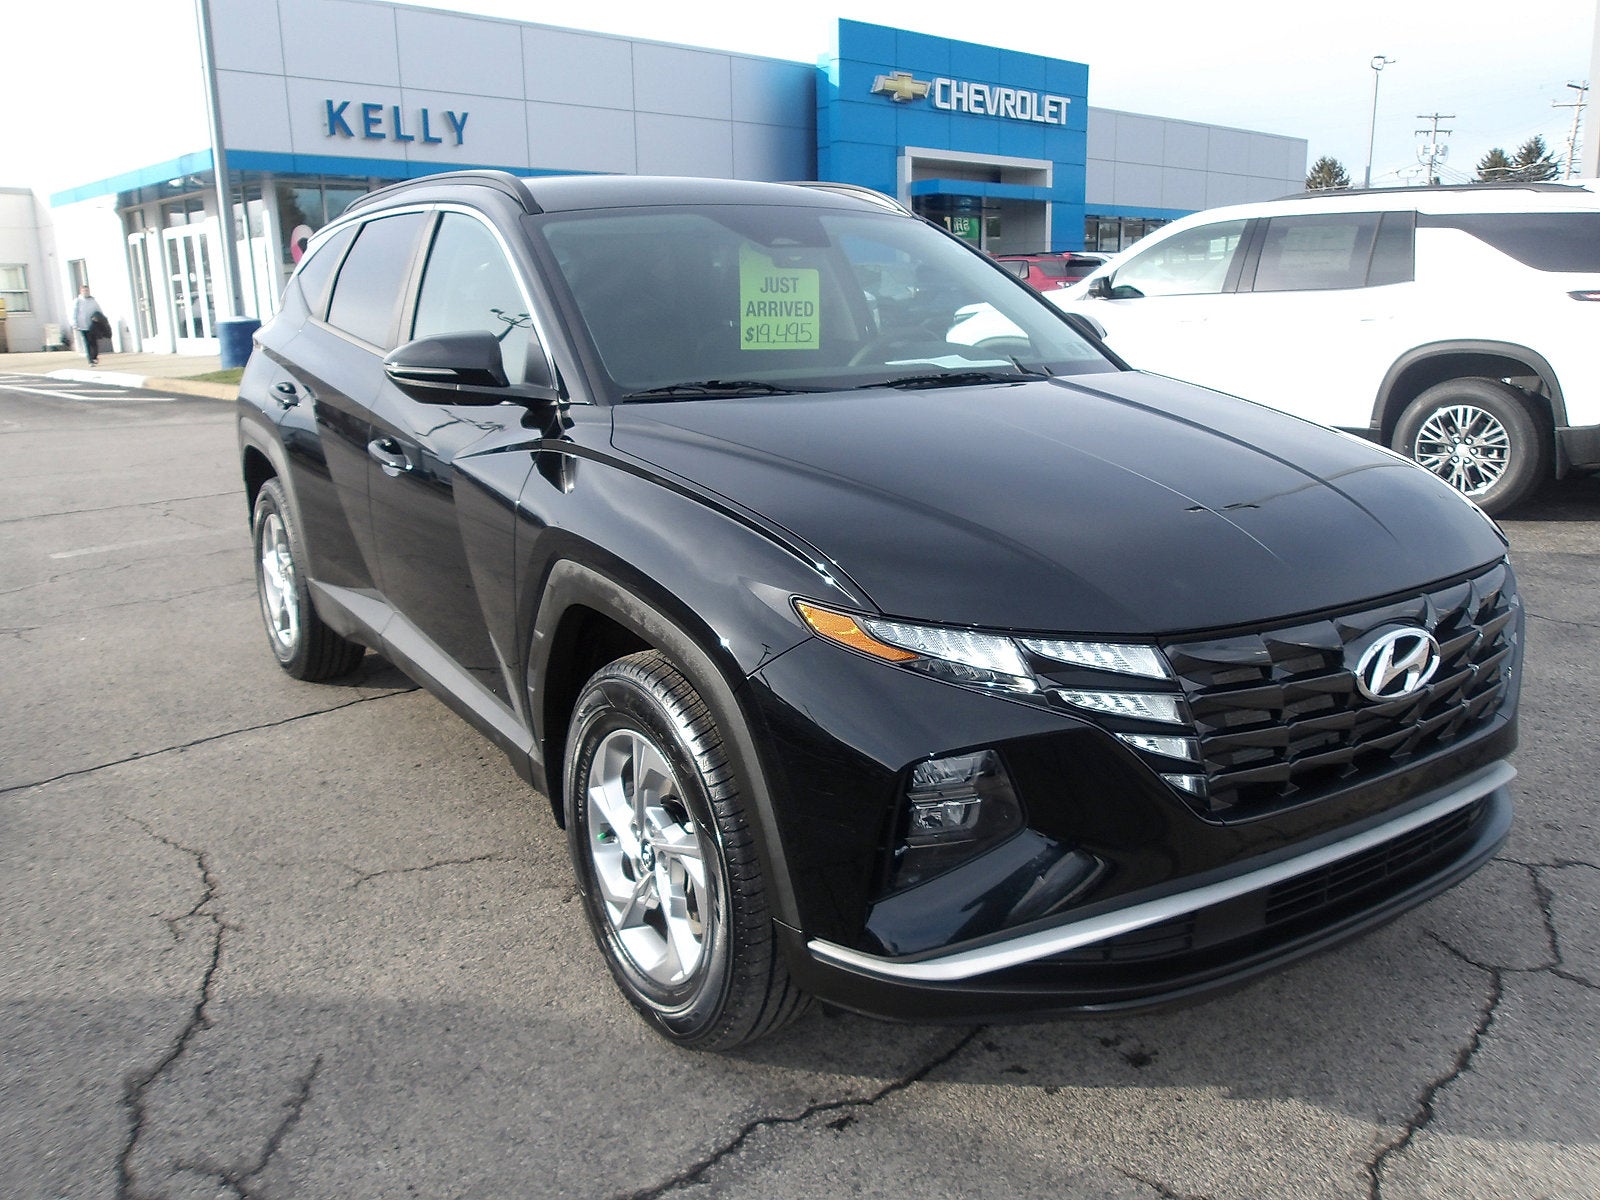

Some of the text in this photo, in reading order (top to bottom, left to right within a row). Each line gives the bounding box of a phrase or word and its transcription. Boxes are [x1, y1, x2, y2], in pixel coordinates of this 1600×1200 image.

[933, 77, 1071, 125] CHEVROLET
[325, 99, 469, 145] KELLY
[760, 277, 799, 293] JUST
[746, 300, 814, 317] ARRIVED
[745, 322, 812, 344] $19,495
